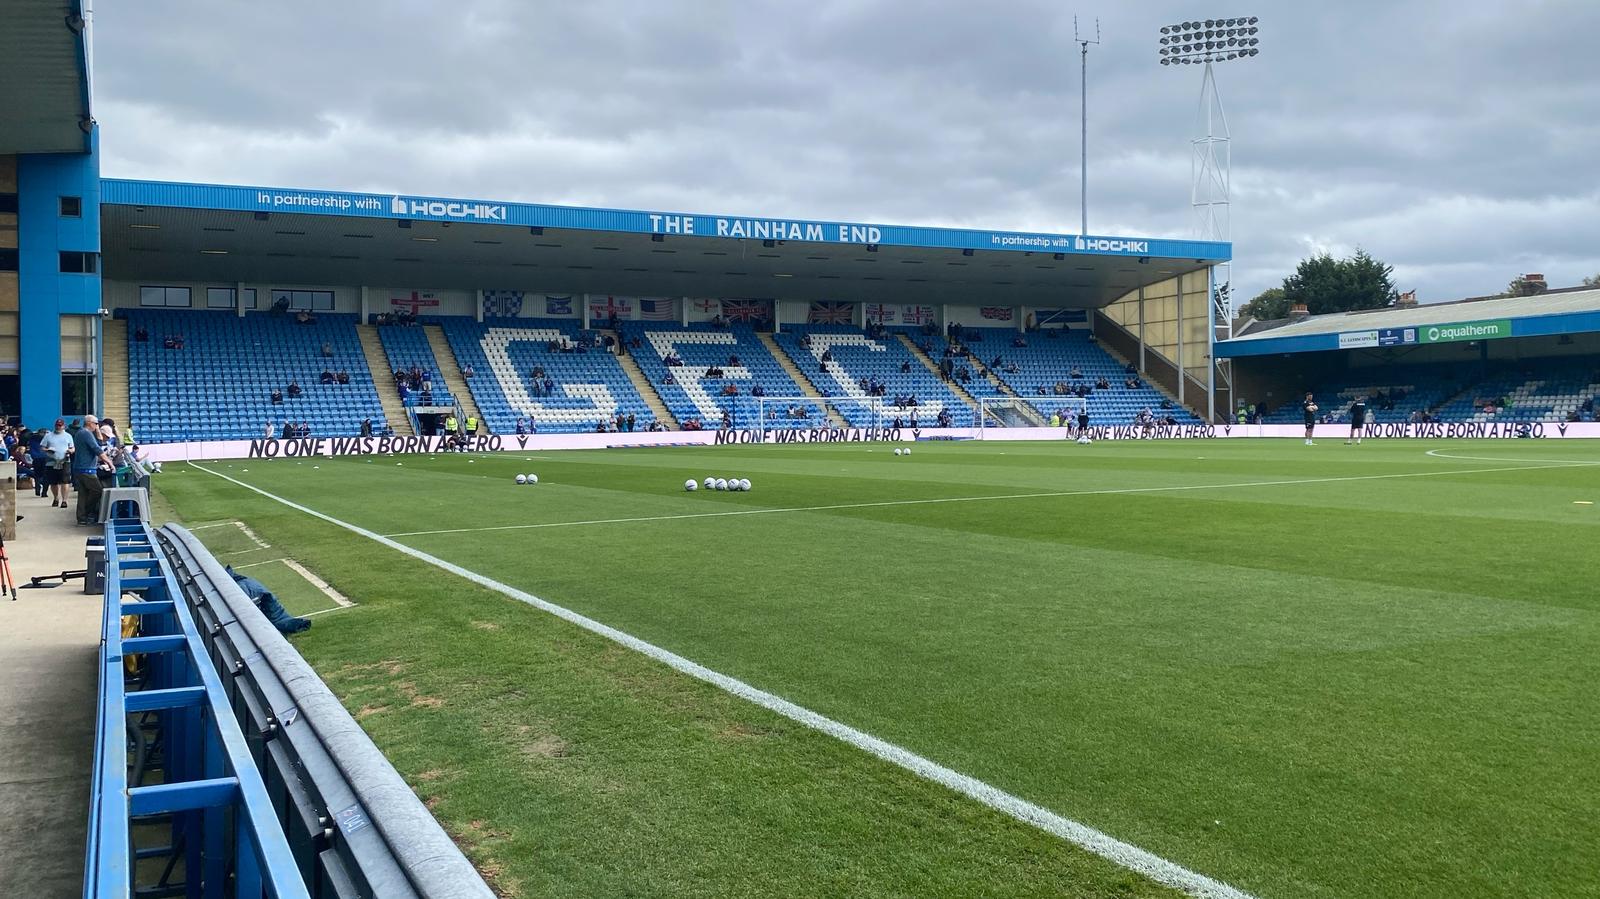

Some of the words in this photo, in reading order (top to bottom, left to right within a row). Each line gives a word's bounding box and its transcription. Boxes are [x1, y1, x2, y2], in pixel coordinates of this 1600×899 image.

[258, 192, 270, 203] In
[274, 194, 351, 210] partnership
[354, 198, 381, 209] with
[411, 201, 506, 220] HOCHIKI
[650, 215, 694, 234] THE
[717, 219, 824, 241] RAINHAM
[839, 226, 882, 243] END
[992, 234, 1000, 244] In
[1002, 235, 1050, 247] partnership
[1051, 238, 1069, 247] with
[1087, 242, 1148, 253] HOCHIKI
[1441, 325, 1499, 339] aquatherm
[714, 430, 737, 445] NO
[740, 429, 770, 444] ONE
[774, 429, 806, 443] WAS
[809, 428, 849, 442] BORN
[851, 428, 861, 442] A
[1086, 426, 1111, 440] ONE
[1113, 425, 1139, 439] WAS
[1174, 425, 1182, 438] A
[1365, 423, 1383, 438] NO
[1385, 423, 1411, 438] ONE
[1414, 423, 1443, 438] WAS
[1446, 423, 1485, 438] BORN
[1488, 422, 1499, 438] A
[249, 438, 279, 458] NO
[284, 437, 325, 457] ONE
[331, 436, 374, 455] WAS
[378, 435, 432, 453] BORN
[434, 435, 449, 452] A
[456, 434, 505, 451] ERO.
